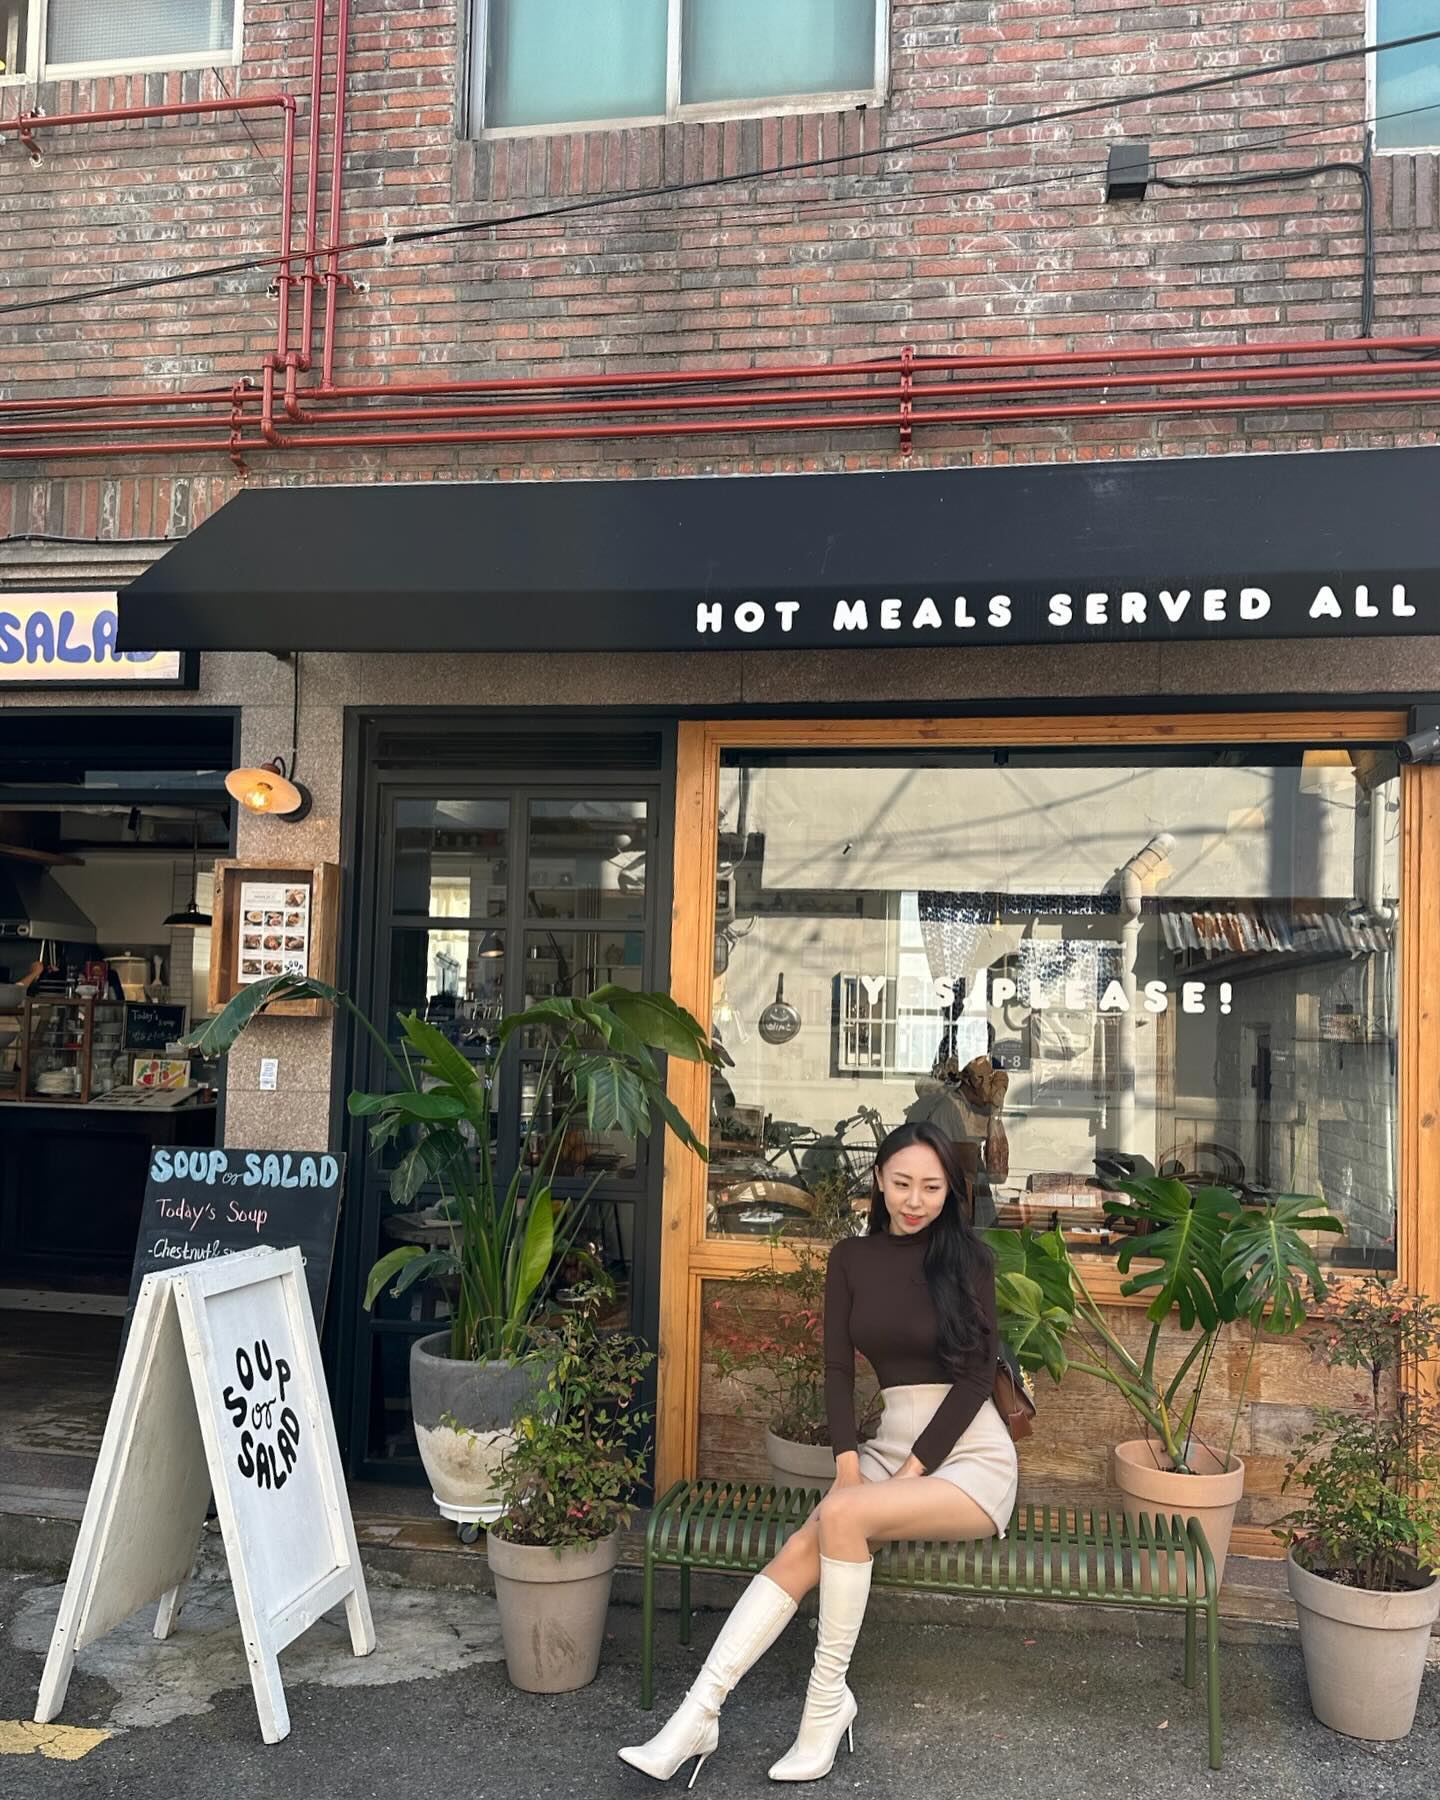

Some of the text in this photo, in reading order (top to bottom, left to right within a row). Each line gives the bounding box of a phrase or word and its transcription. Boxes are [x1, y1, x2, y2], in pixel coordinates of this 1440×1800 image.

[696, 584, 1416, 633] HOT MEALS SERVED ALL
[0, 610, 157, 664] SALA
[992, 978, 1232, 1014] PLEASE!
[151, 1150, 339, 1189] SOUP or SALAD
[156, 1199, 268, 1233] Today's Soup
[223, 1339, 291, 1427] SOUP
[251, 1397, 277, 1431] or
[238, 1407, 300, 1490] SALAD
